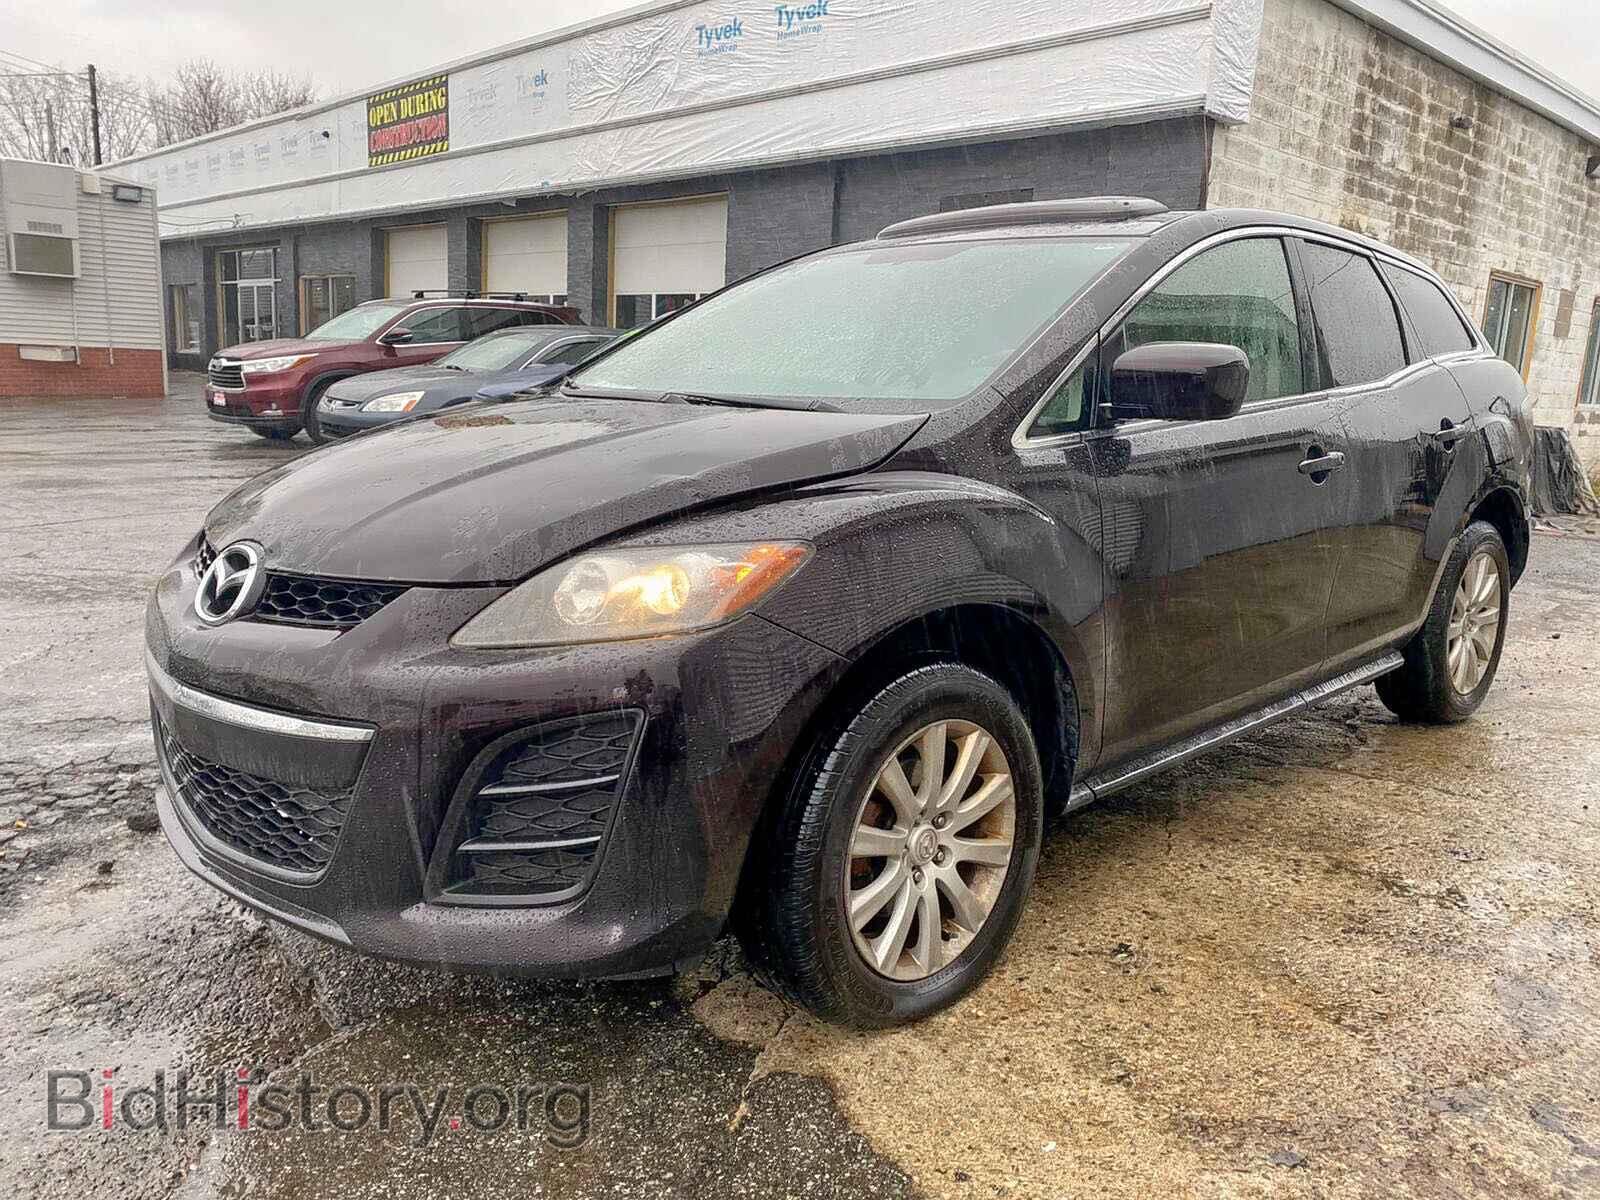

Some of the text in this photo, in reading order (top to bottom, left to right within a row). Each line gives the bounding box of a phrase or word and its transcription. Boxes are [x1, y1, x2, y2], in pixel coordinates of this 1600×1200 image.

[775, 0, 829, 31] Tyvek
[695, 17, 743, 48] Tyvek
[777, 24, 823, 41] HomeWrap
[369, 101, 398, 127] OPEN
[400, 86, 446, 119] DURING
[370, 112, 447, 153] CONSTRUCTION
